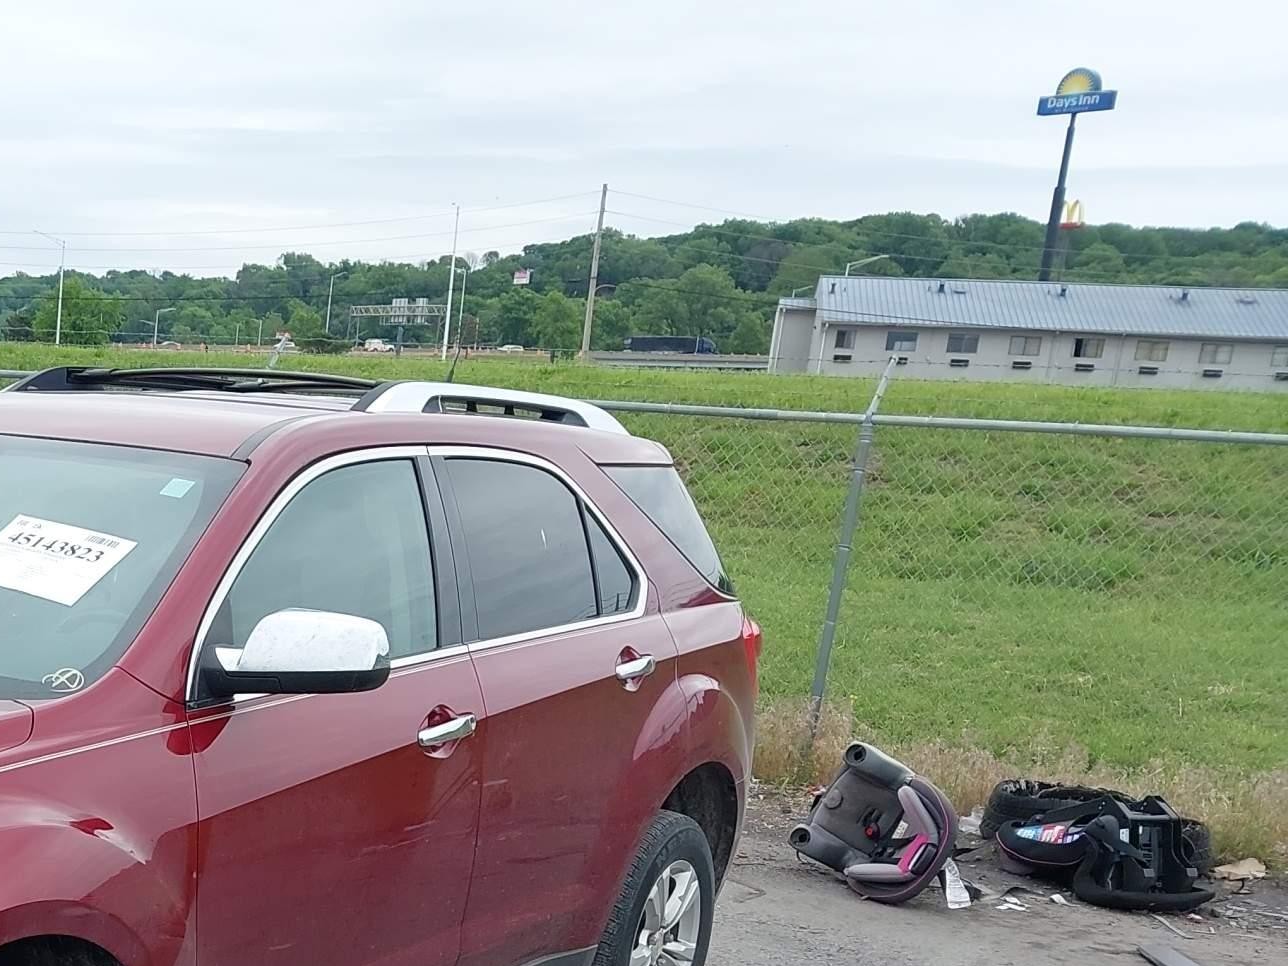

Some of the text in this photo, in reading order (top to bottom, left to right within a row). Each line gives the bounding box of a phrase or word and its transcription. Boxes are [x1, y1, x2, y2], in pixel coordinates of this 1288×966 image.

[1047, 94, 1100, 109] Days Inn
[8, 532, 104, 562] 45143823
